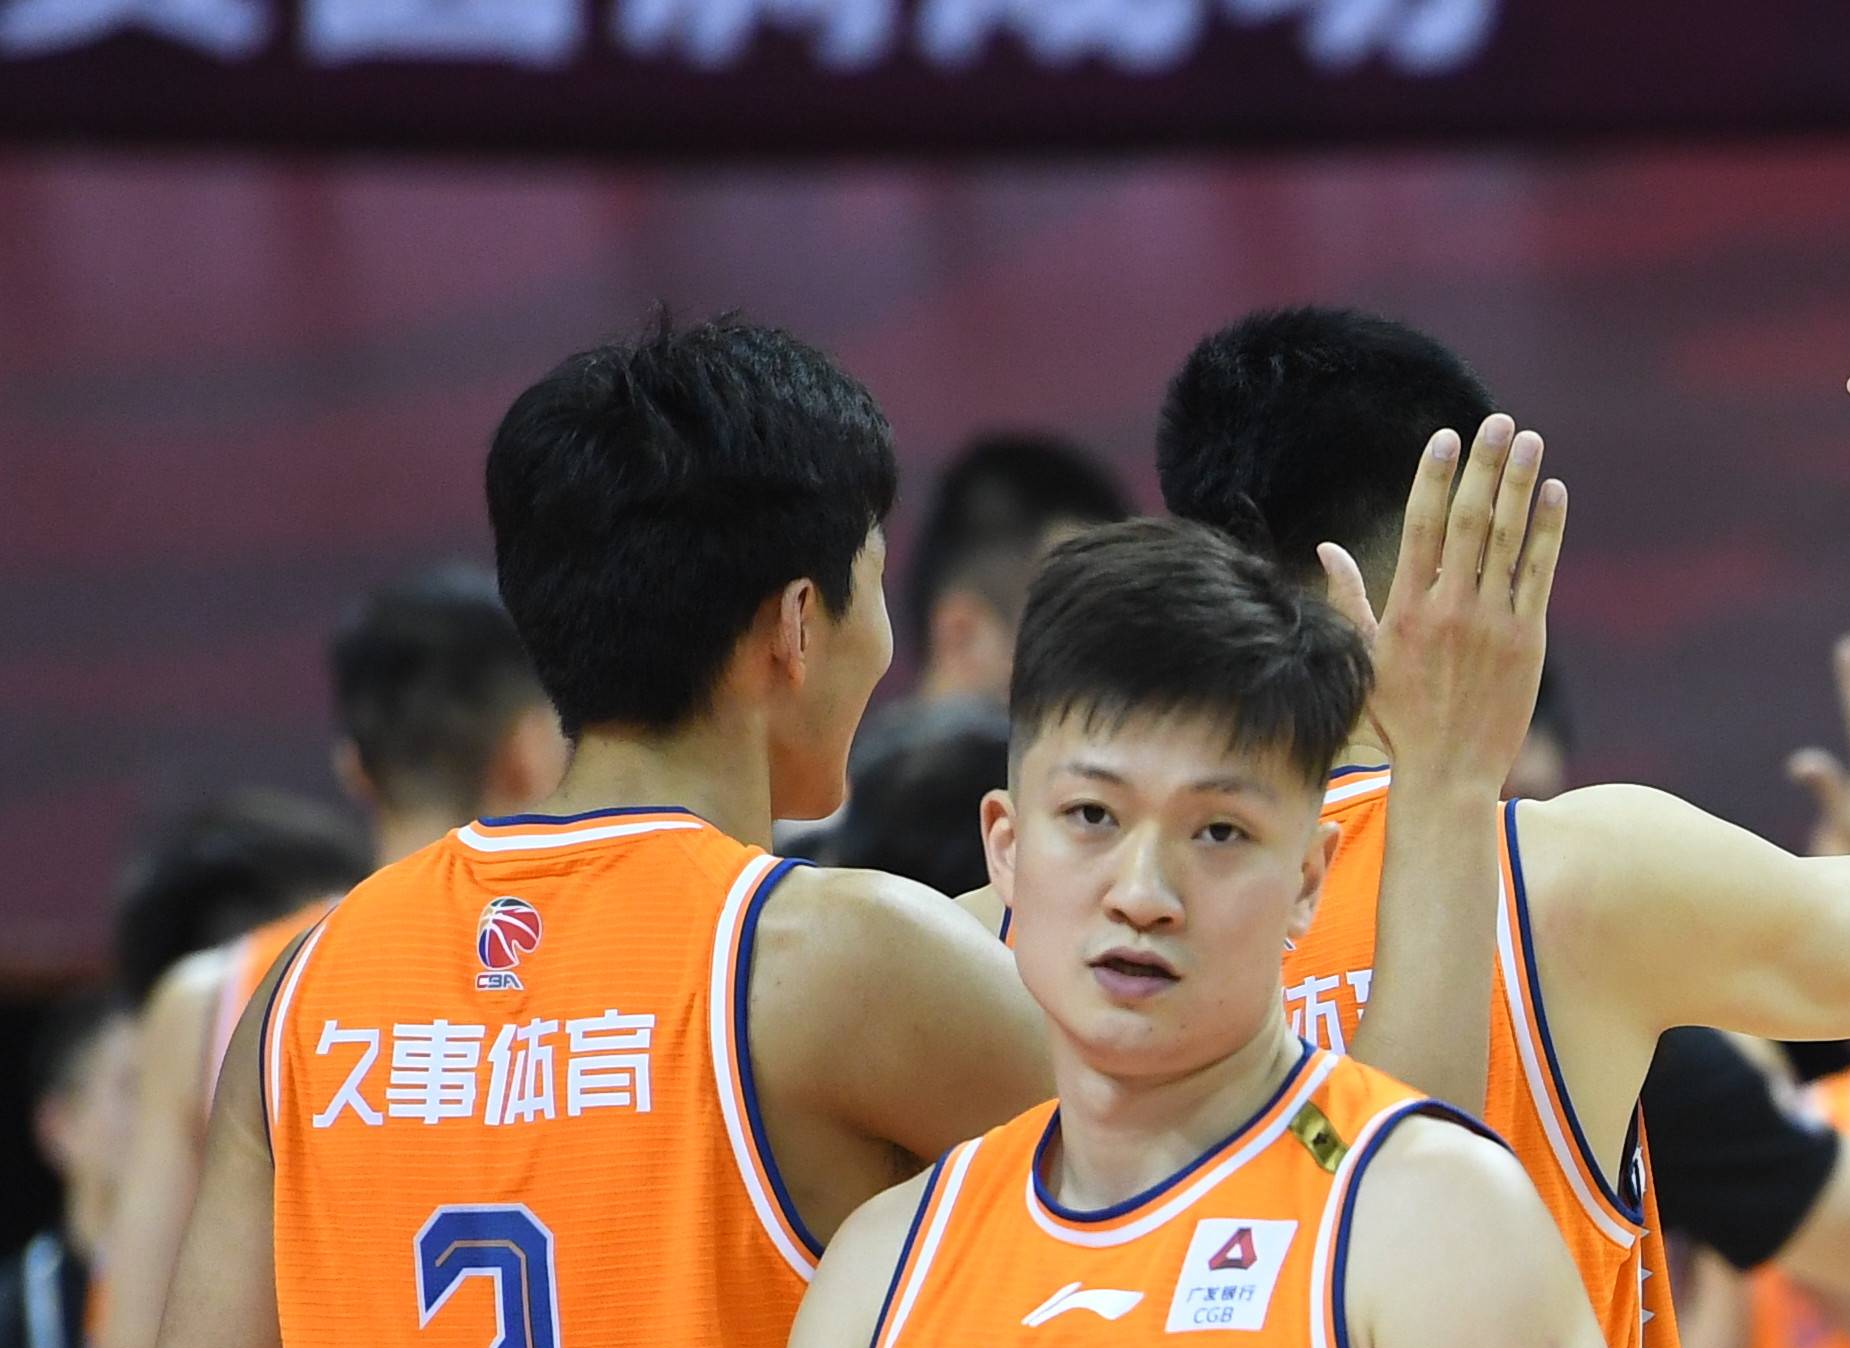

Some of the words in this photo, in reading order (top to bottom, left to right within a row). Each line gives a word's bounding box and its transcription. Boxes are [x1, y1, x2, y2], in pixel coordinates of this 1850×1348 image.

[475, 971, 524, 990] CBA
[312, 1009, 655, 1128] 久事体育
[1193, 1306, 1235, 1324] CGB
